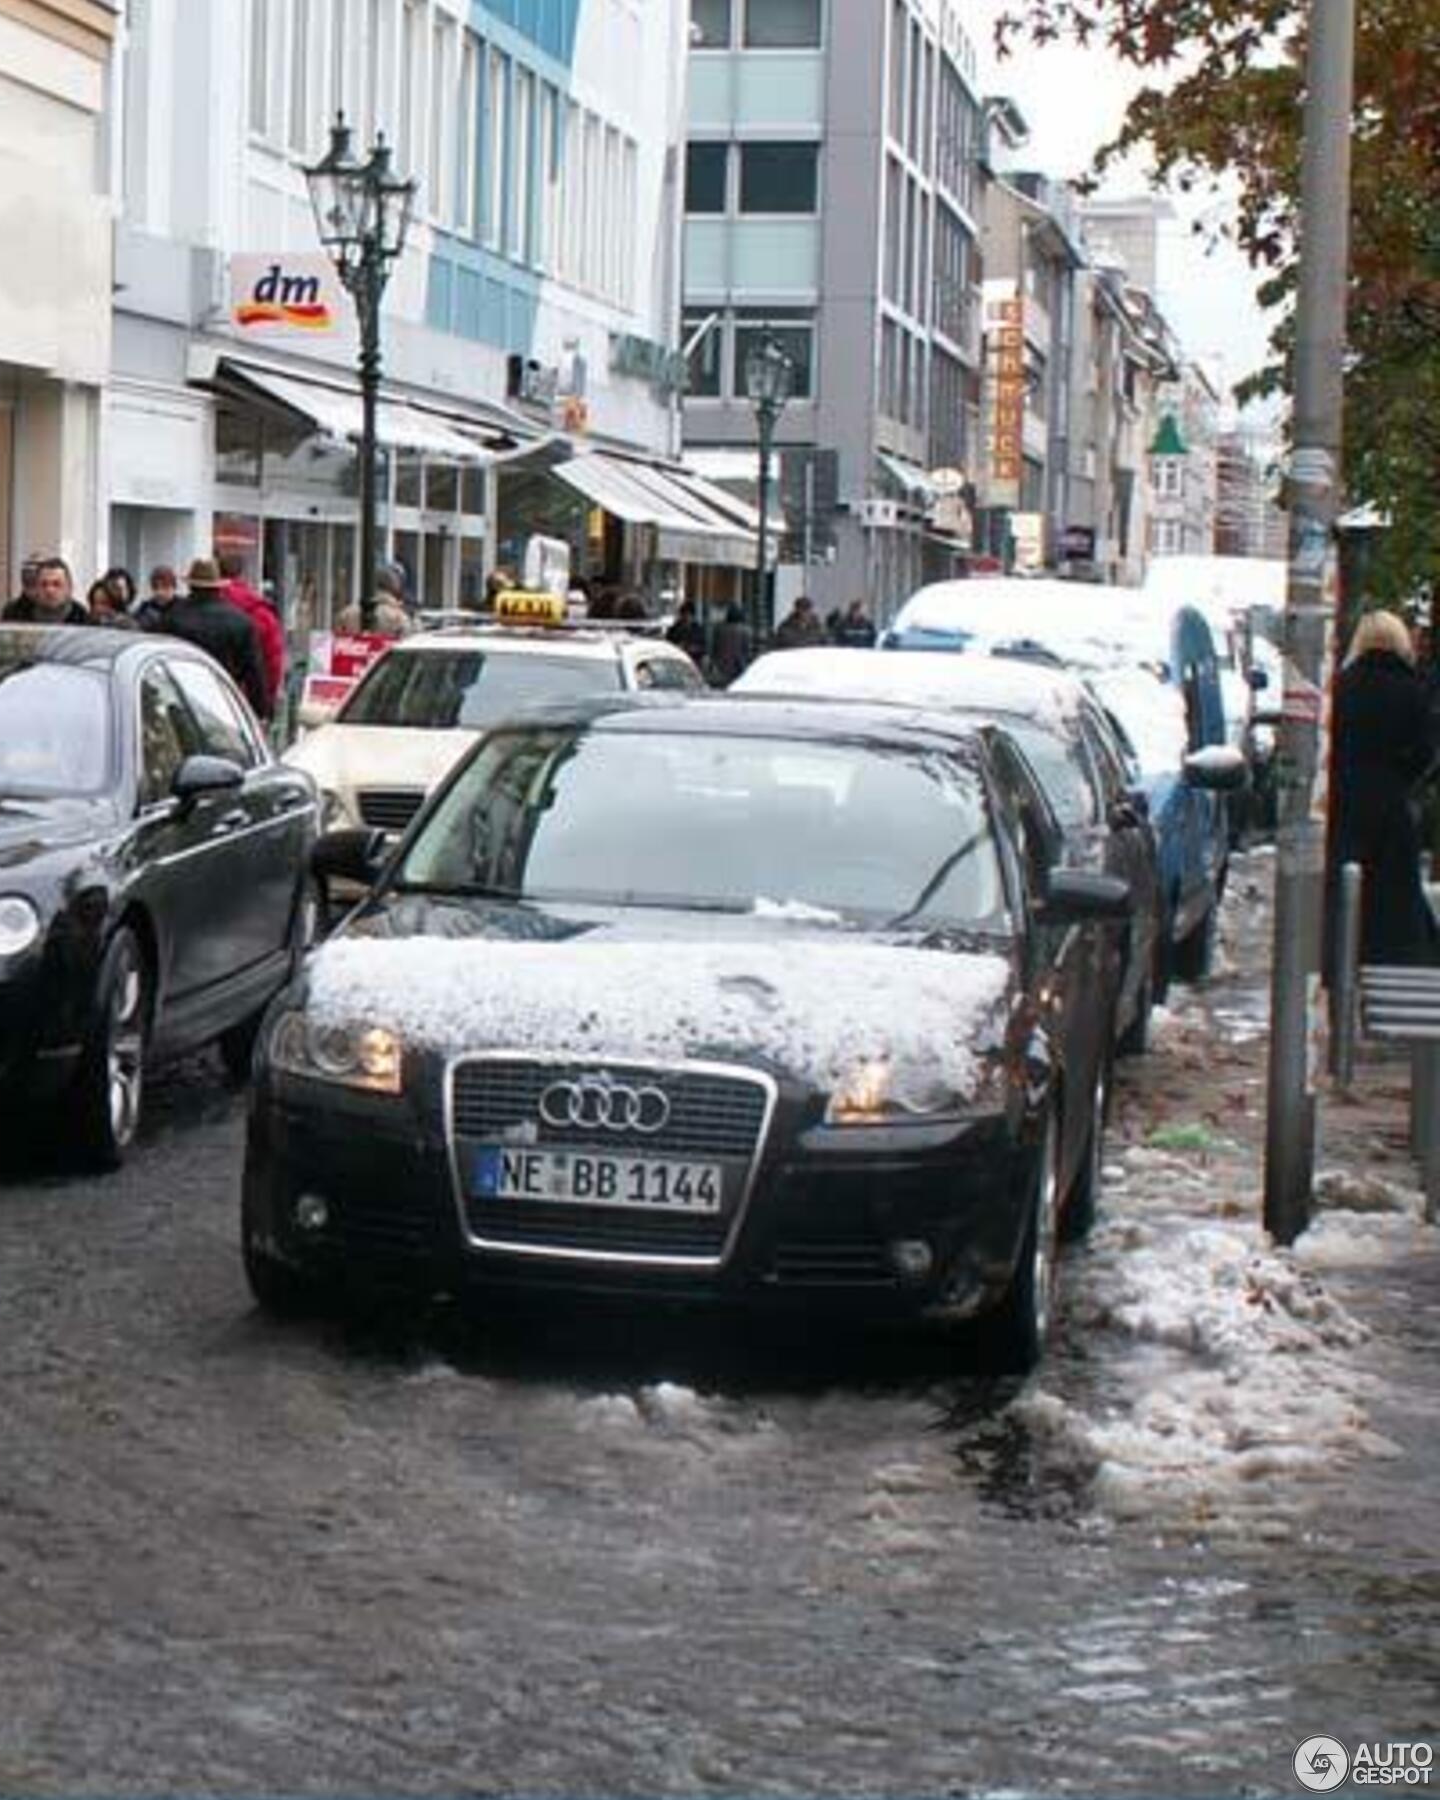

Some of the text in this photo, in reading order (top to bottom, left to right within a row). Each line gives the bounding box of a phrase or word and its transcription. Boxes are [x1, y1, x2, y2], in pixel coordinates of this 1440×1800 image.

[254, 265, 318, 303] dm
[500, 1154, 717, 1205] NE BB 1144
